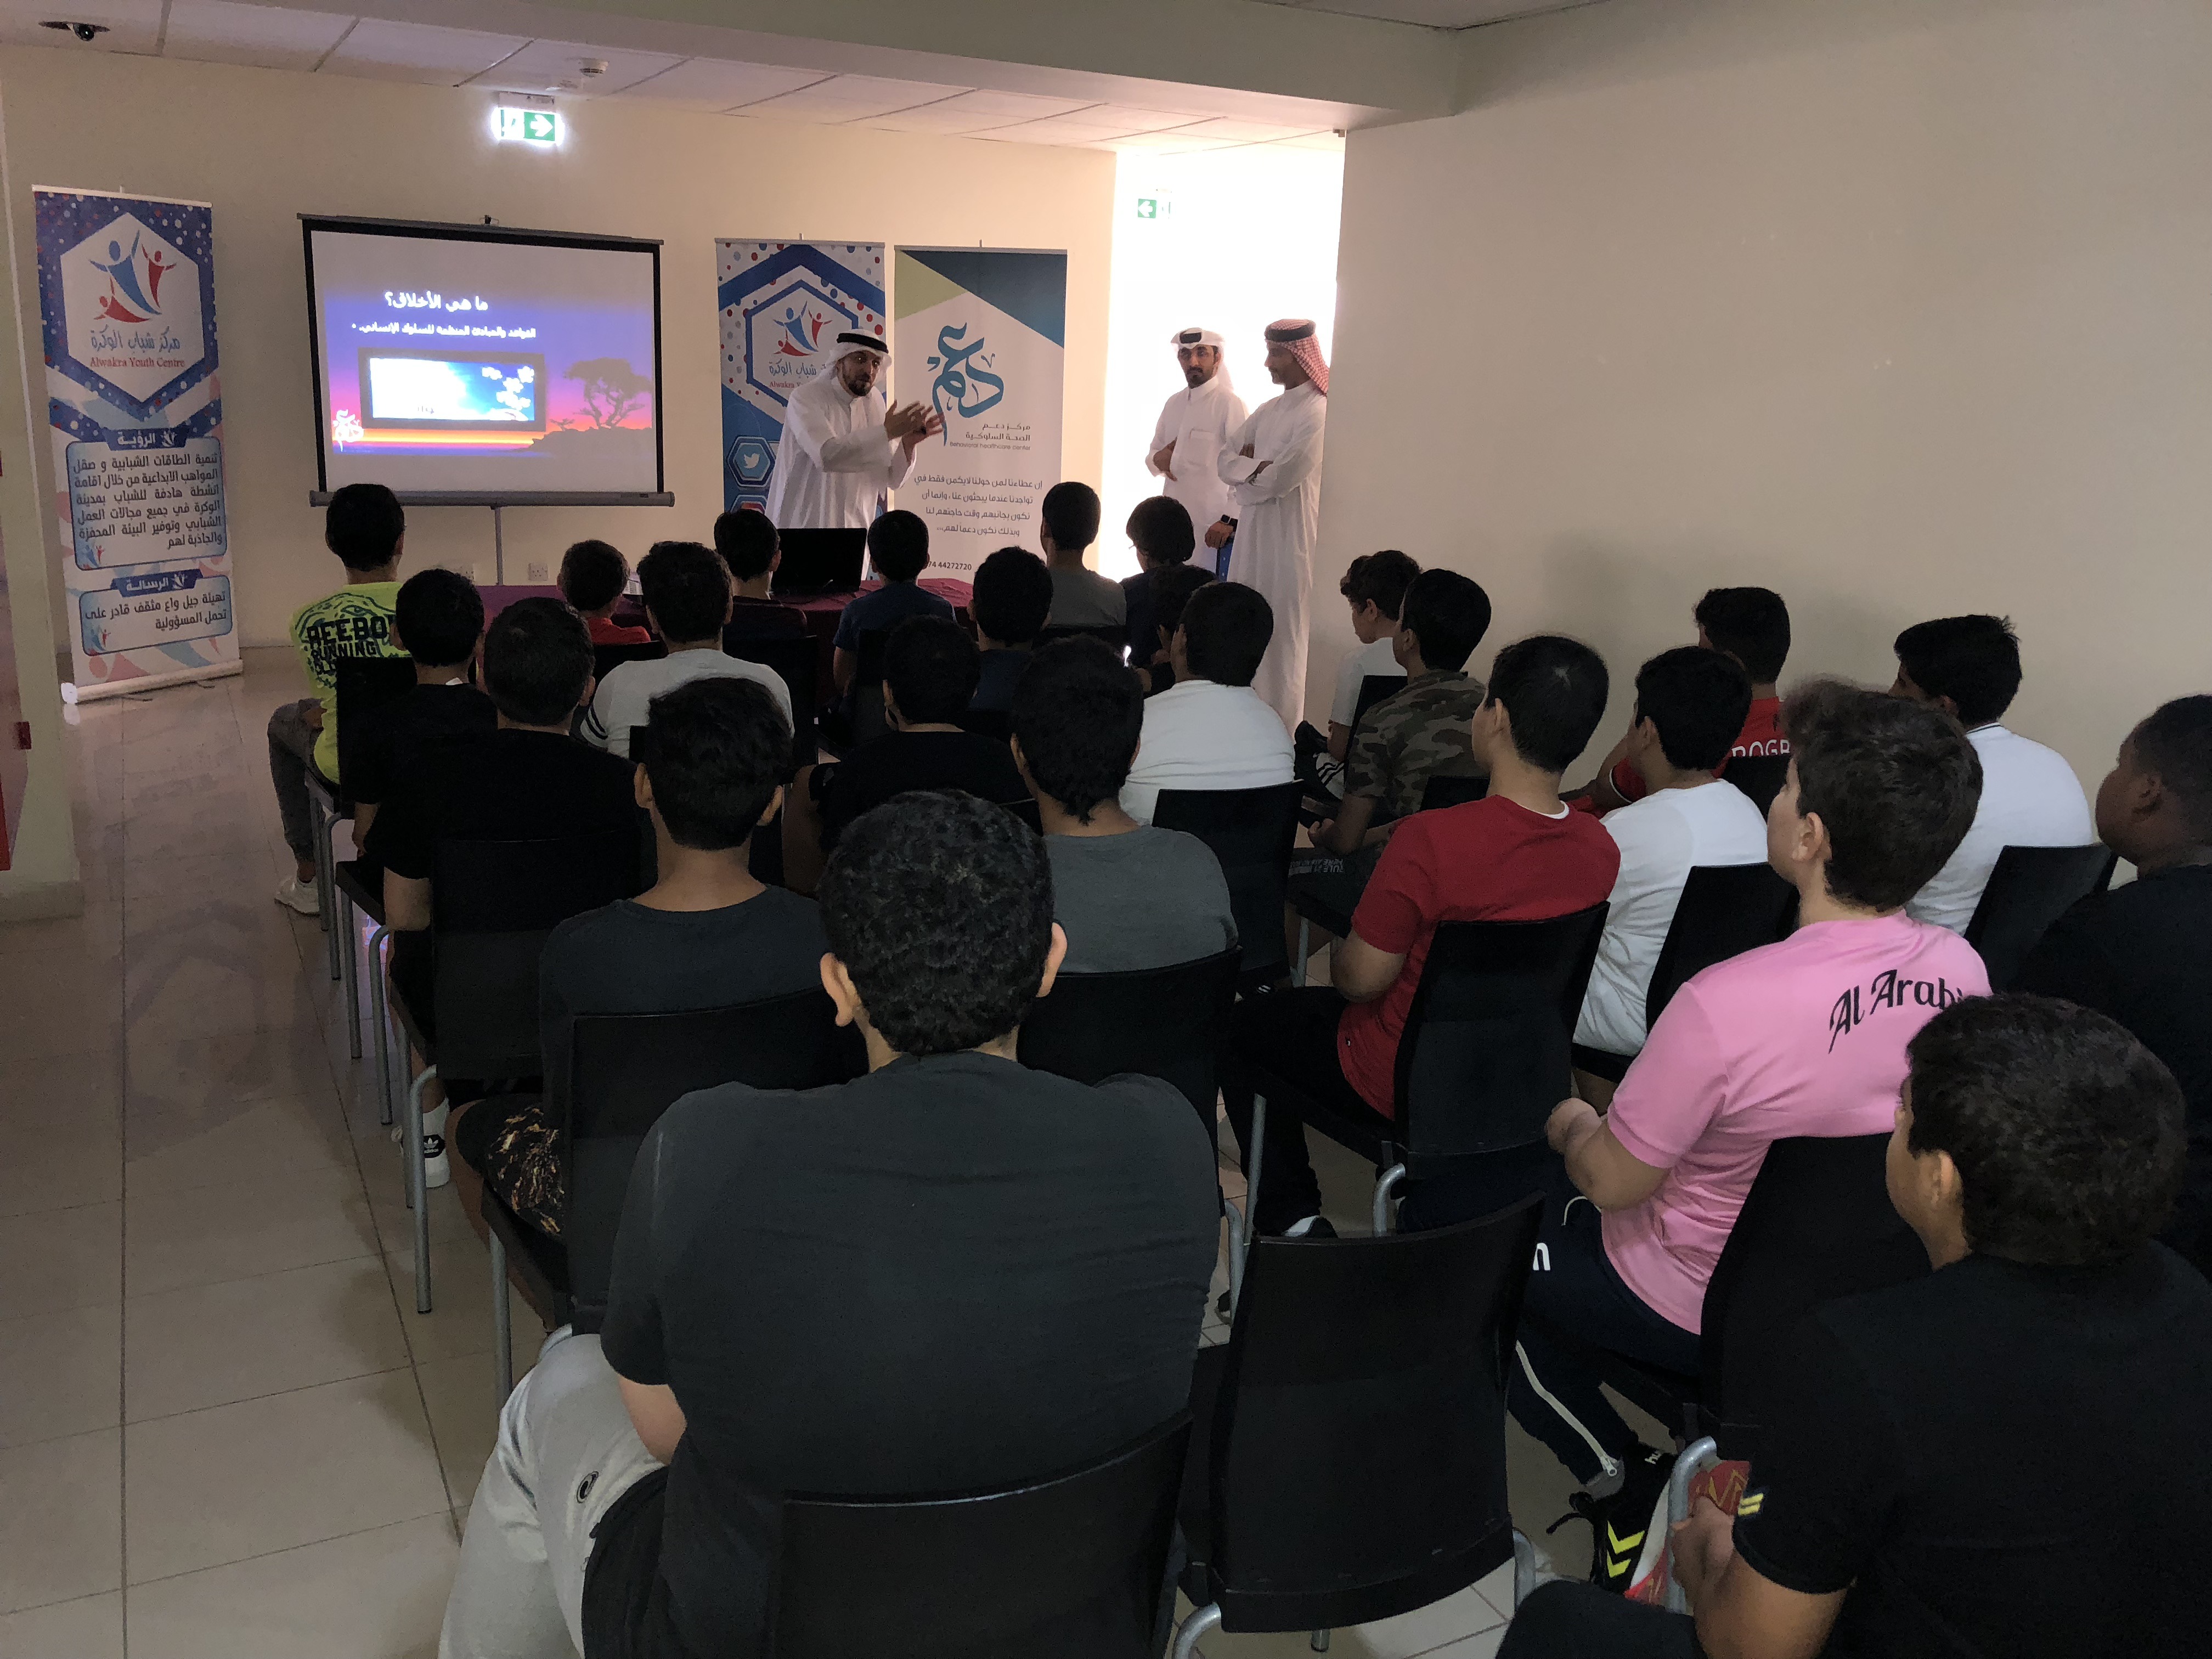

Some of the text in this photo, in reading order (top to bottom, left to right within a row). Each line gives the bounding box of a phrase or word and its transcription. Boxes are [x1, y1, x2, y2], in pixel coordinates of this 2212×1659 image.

[475, 296, 488, 311] ما
[91, 324, 180, 354] مركز شباب الوكرة
[90, 357, 185, 368] Alwakra Youth Centre
[769, 358, 792, 376] الوكرة
[796, 362, 817, 379] شباب
[74, 453, 217, 474] تنمية الطاقات الشبابية و صقل
[104, 473, 123, 489] خلال
[126, 475, 140, 488] من
[180, 469, 218, 482] المواهب
[914, 474, 927, 486] في
[928, 474, 945, 483] فقط
[972, 477, 990, 487] حولنا
[992, 478, 1007, 488] لمن
[114, 489, 146, 504] للشباب
[155, 487, 183, 499] هادفة
[989, 493, 1007, 503] عندما
[77, 500, 220, 526] الوكرة في جميع مجالات العمل
[964, 510, 980, 519] وقت
[981, 511, 1009, 521] بجانبهم
[1011, 512, 1030, 521] نكون
[79, 516, 221, 541] الشبابي وتوفير البيئة المحفزة
[977, 526, 996, 535] نكون
[167, 532, 222, 550] والجاذبة لهم
[938, 562, 972, 571] 44272720
[85, 591, 225, 620] تهيئة جيل واع مثقف قادر على
[155, 609, 227, 631] تحمل المسؤولية
[1829, 985, 1865, 1054] Al
